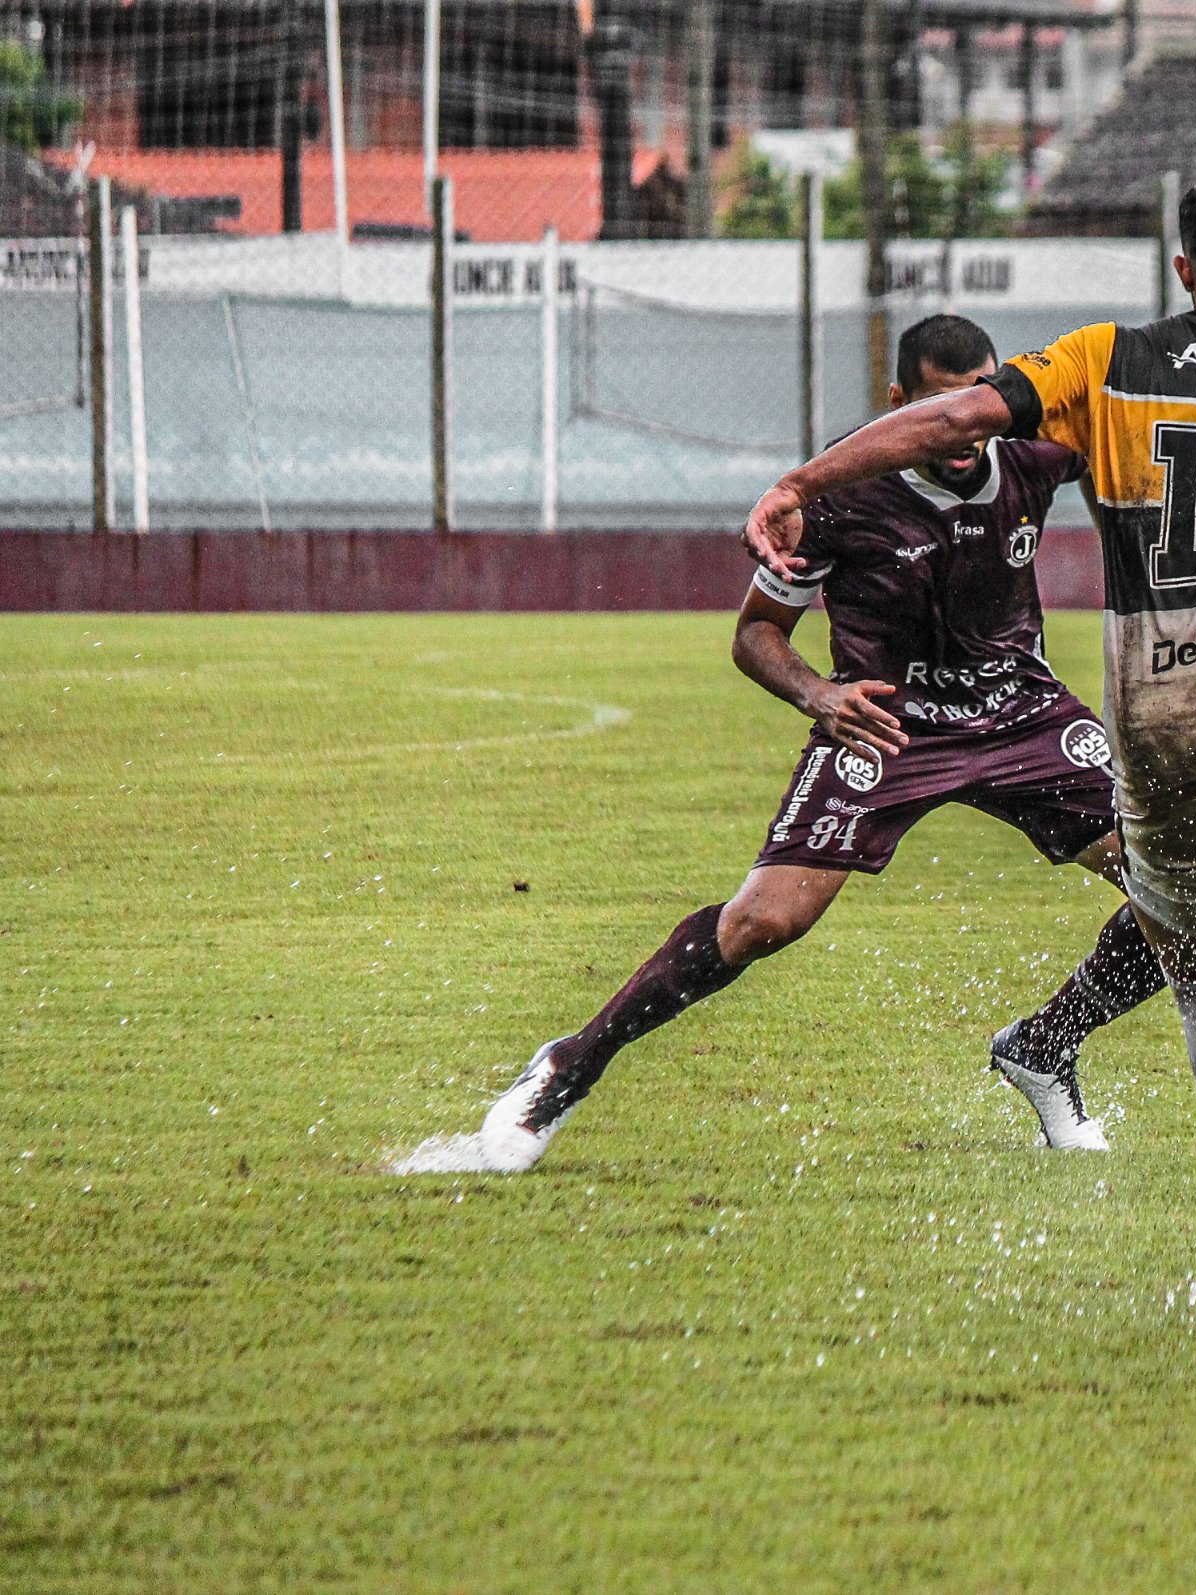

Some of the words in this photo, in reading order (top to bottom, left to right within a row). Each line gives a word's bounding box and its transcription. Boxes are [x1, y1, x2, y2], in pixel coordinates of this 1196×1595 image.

[1071, 730, 1106, 761] 105
[842, 755, 875, 779] 105
[806, 814, 864, 851] 94
